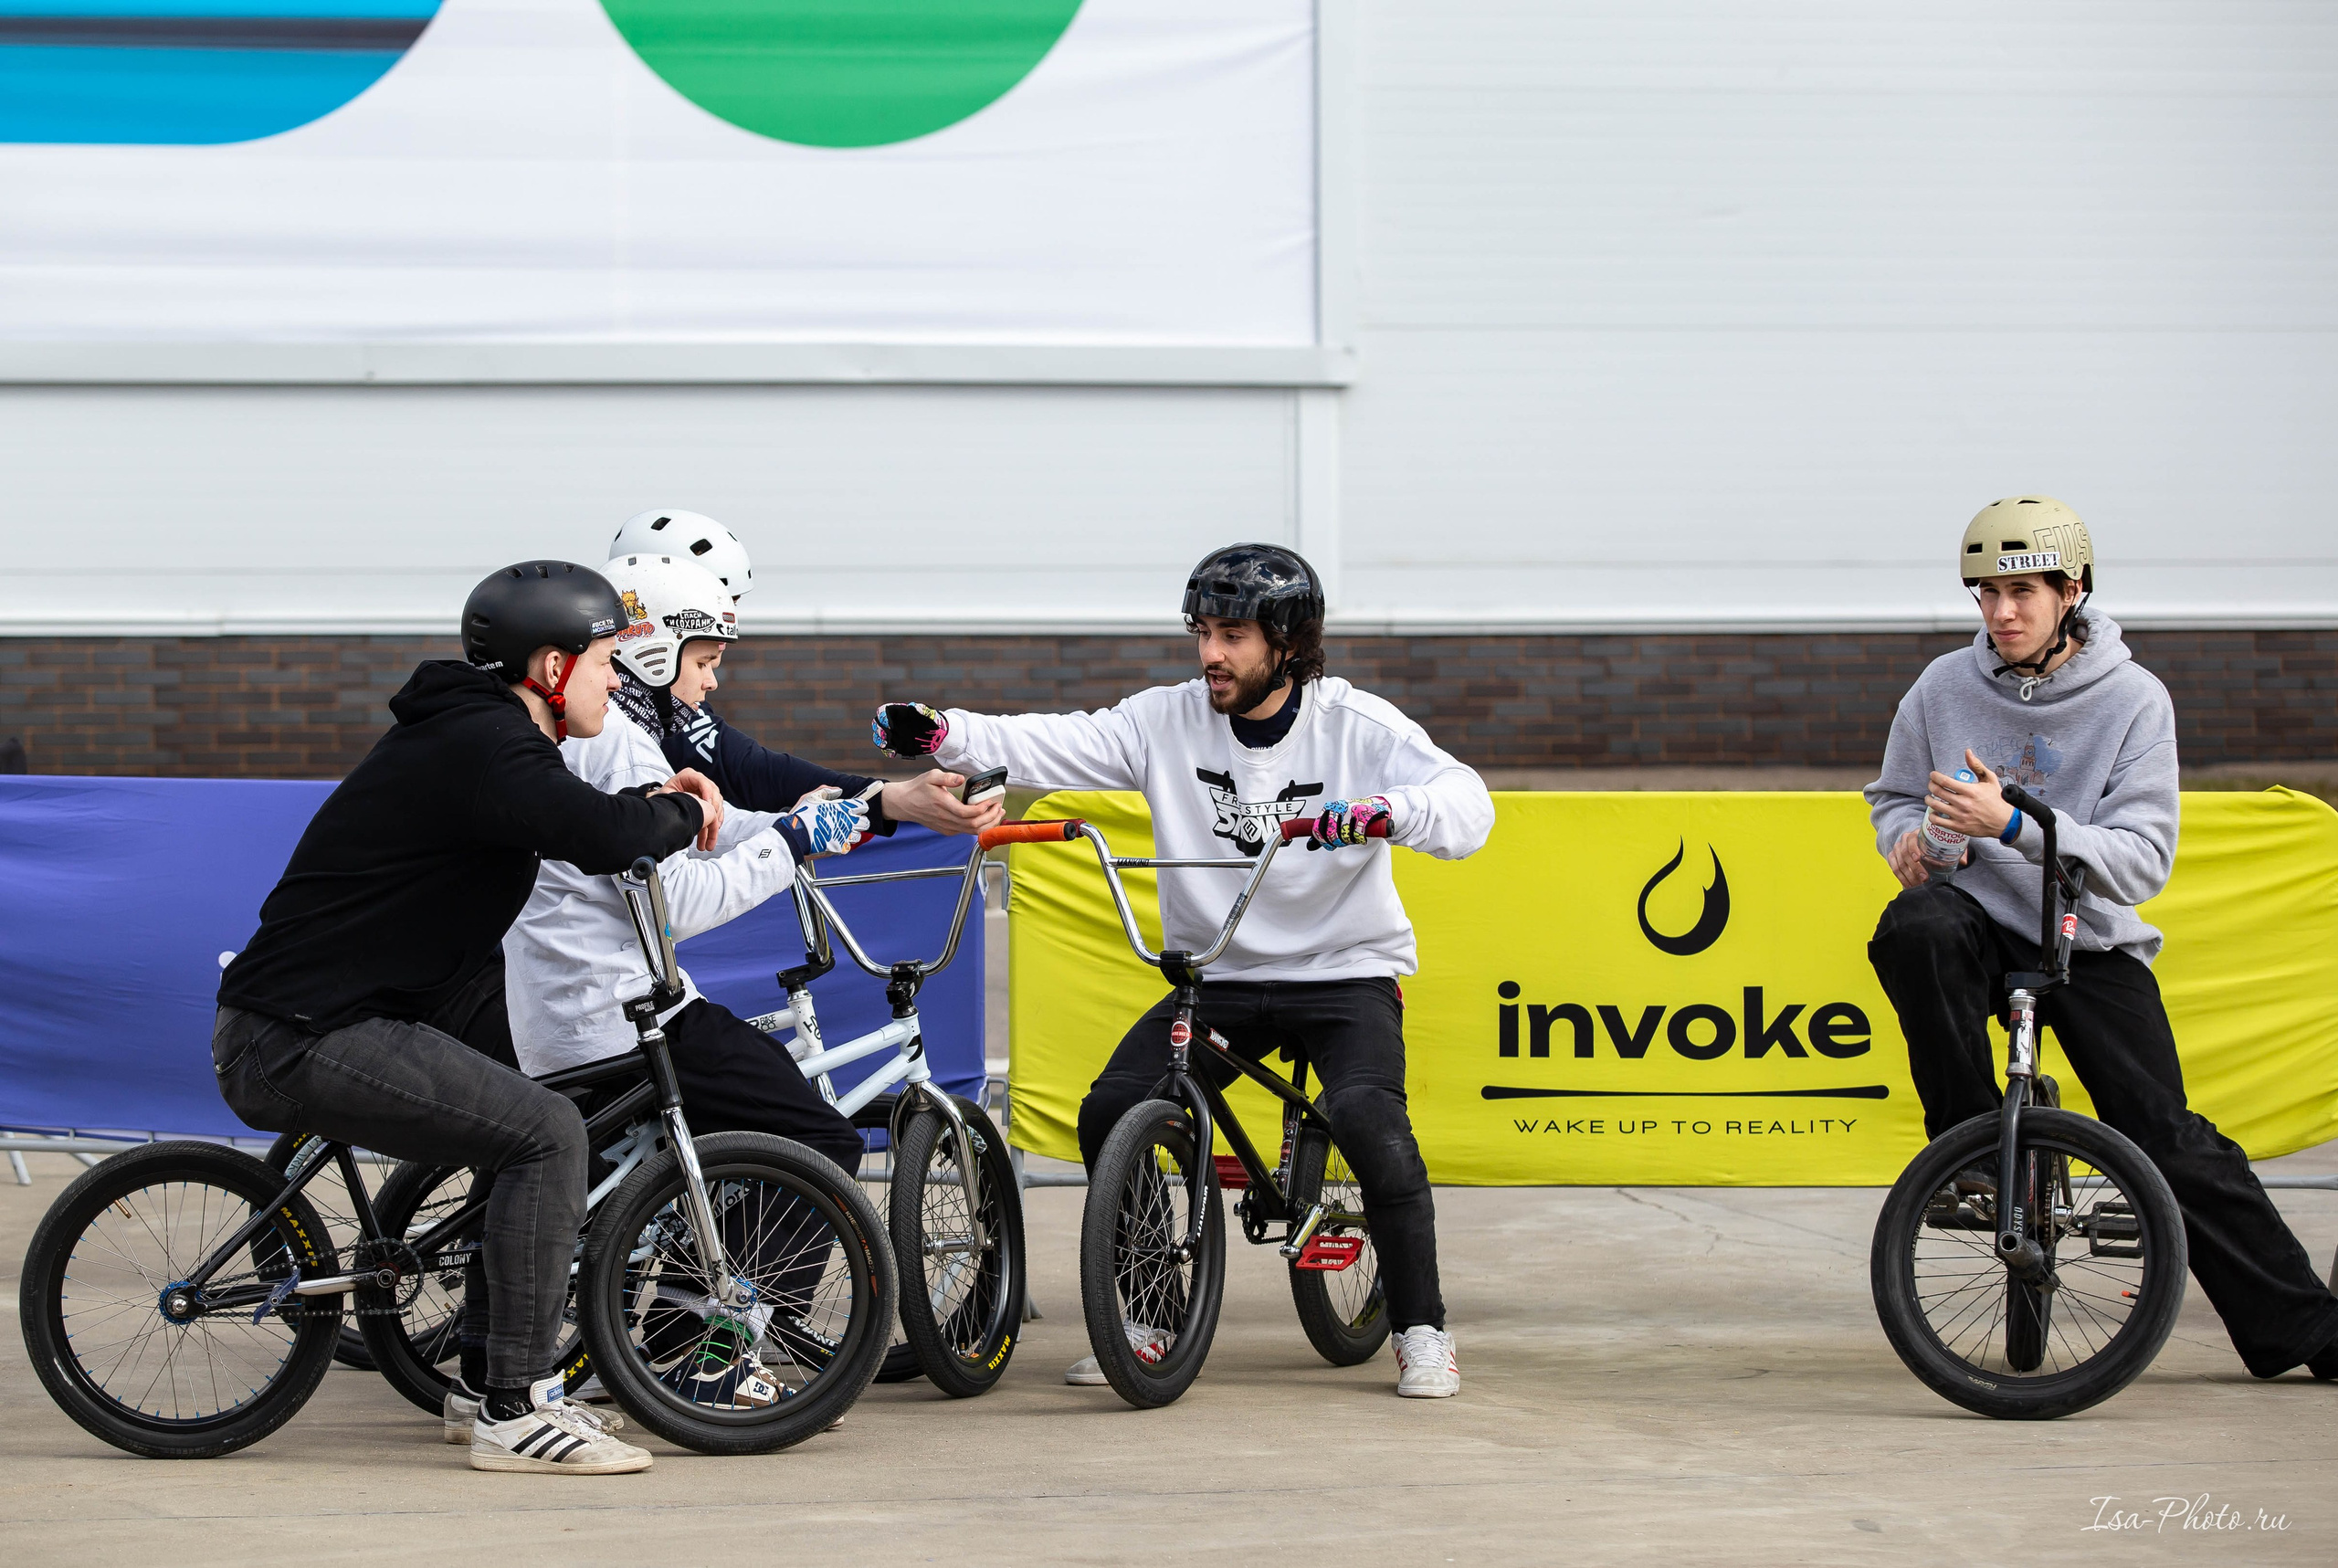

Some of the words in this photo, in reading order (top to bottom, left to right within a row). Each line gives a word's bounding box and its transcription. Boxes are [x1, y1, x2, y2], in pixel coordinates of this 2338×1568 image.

[1998, 553, 2059, 571] STREET
[635, 1001, 654, 1012] PROFILE
[1497, 980, 1872, 1060] invoke
[1513, 1119, 1606, 1134] WAKE
[1619, 1120, 1659, 1134] UP
[1670, 1120, 1711, 1135] TO
[1726, 1119, 1859, 1134] REALITY
[438, 1253, 471, 1267] COLONY
[988, 1334, 1010, 1370] MAXXIS
